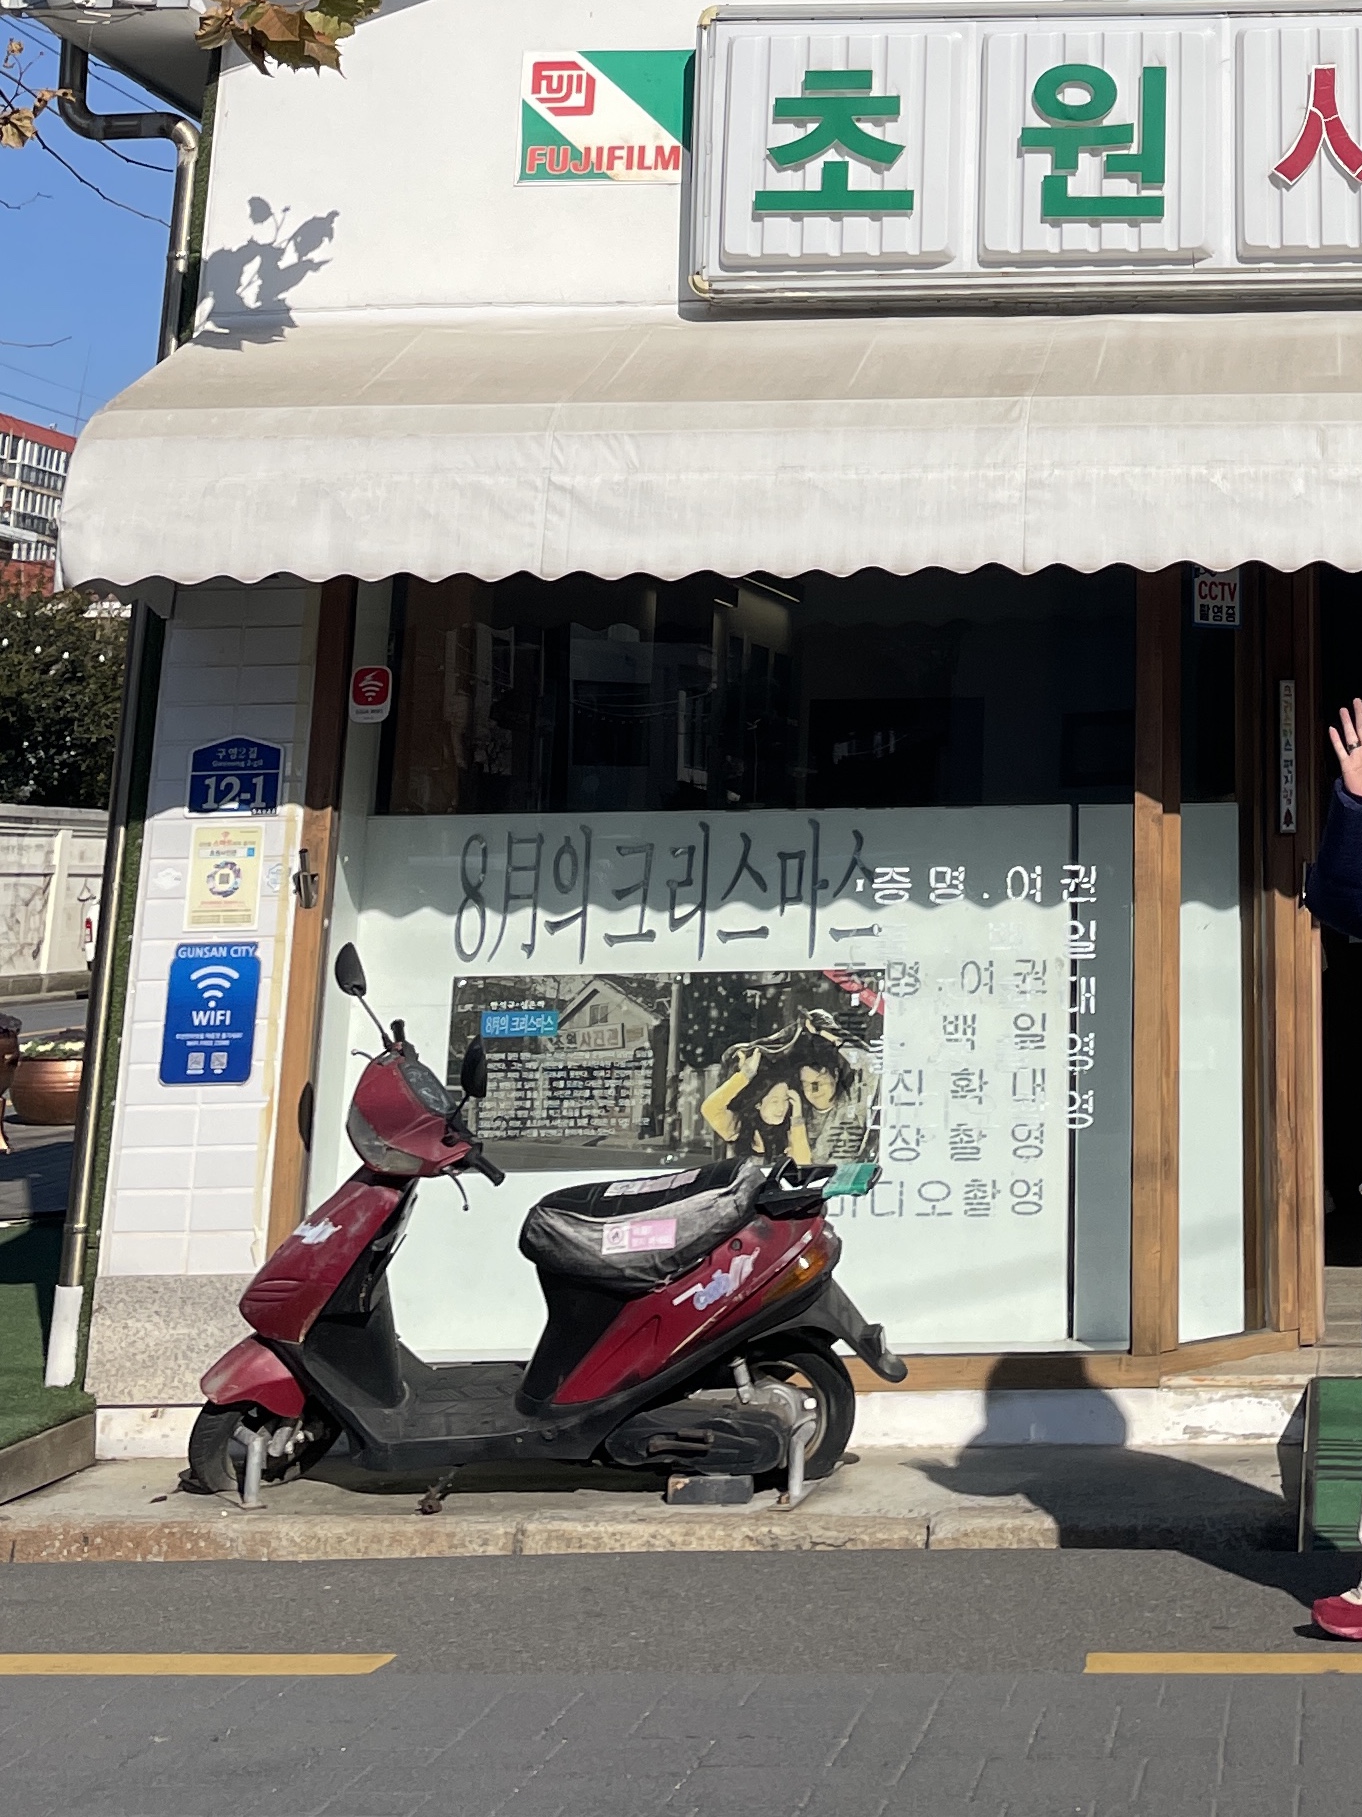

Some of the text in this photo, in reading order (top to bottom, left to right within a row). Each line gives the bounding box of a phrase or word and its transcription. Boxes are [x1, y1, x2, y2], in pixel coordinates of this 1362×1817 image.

[525, 144, 682, 174] FUJIFILM
[1198, 580, 1237, 602] CCTV
[202, 775, 267, 809] 12-1
[178, 945, 256, 959] GUNSAN CITY
[191, 1010, 231, 1026] WIFI
